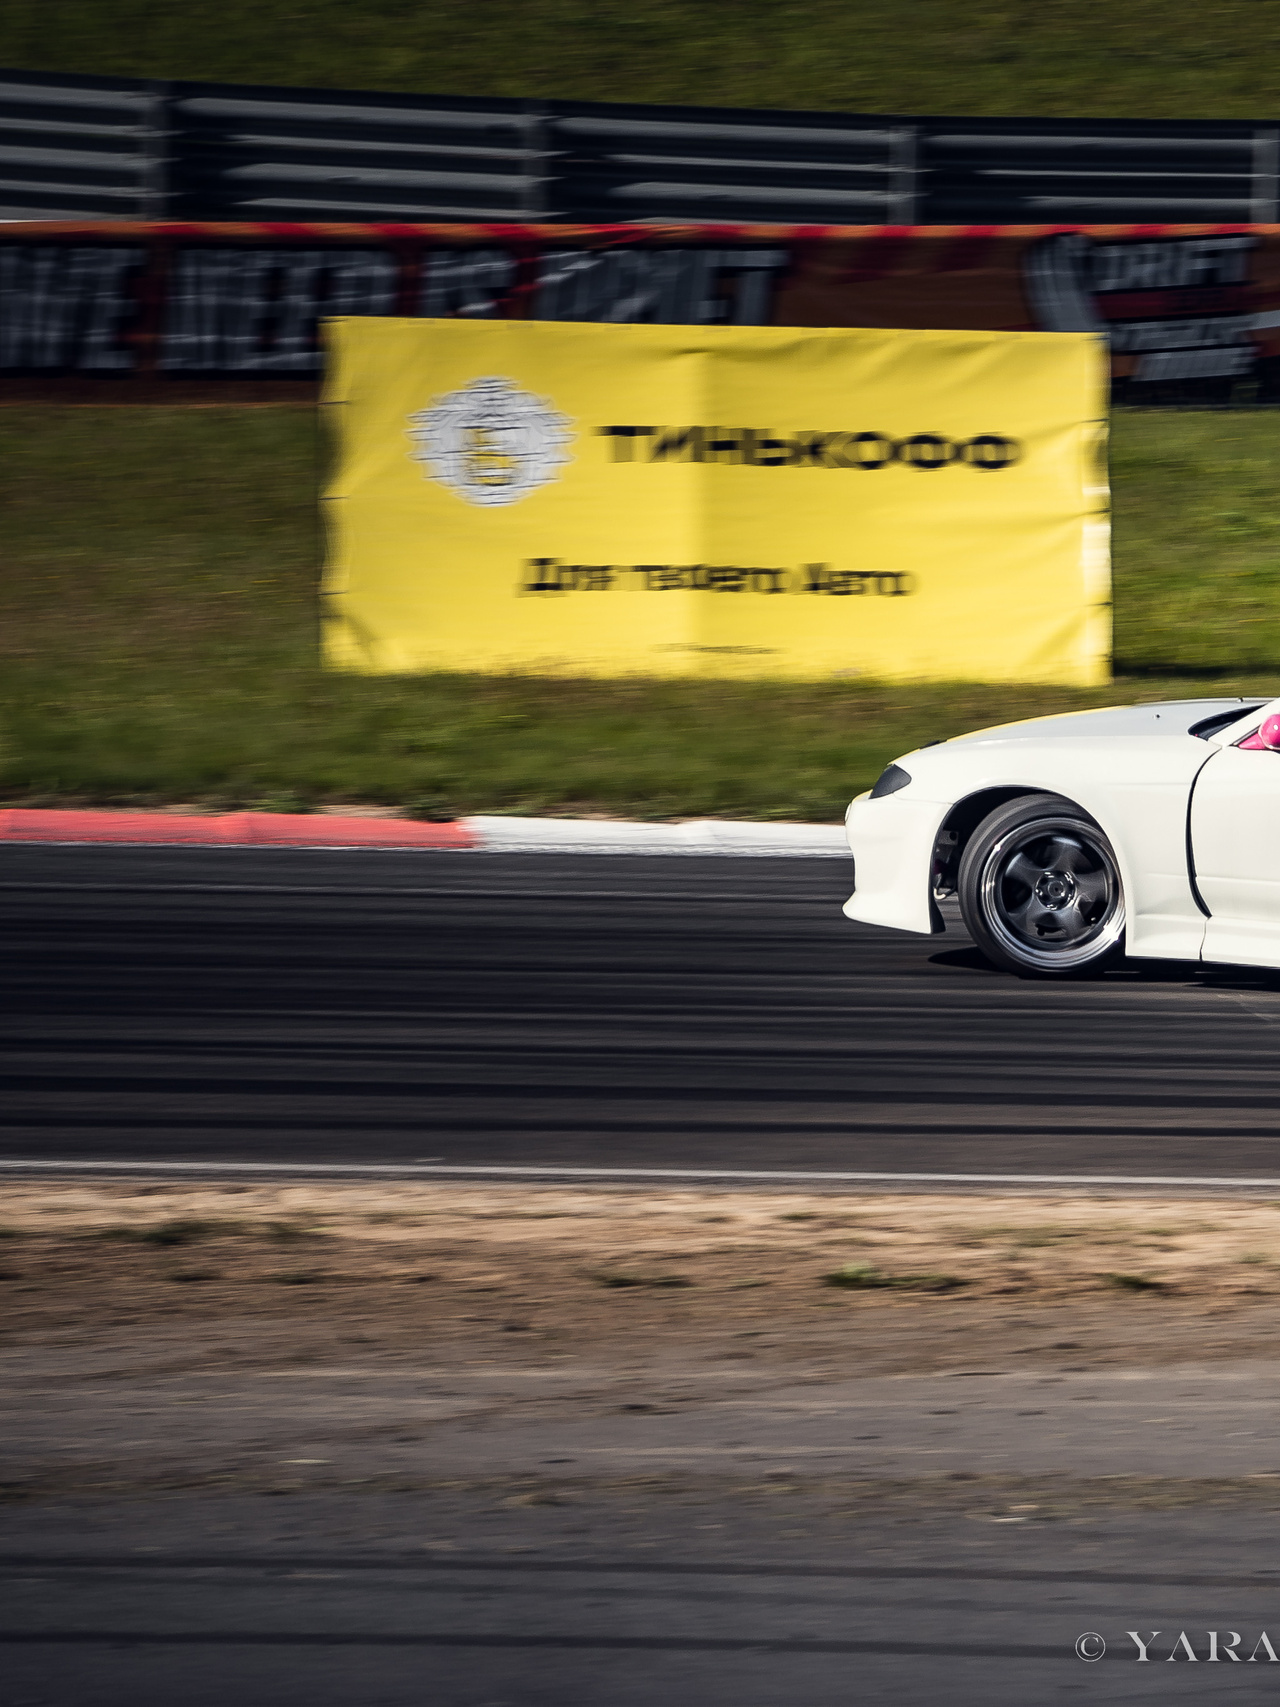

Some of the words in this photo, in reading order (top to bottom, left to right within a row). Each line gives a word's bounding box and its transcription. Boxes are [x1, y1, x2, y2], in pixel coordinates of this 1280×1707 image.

[593, 425, 1024, 473] ТИНЬКОФФ
[516, 557, 613, 597] Для
[622, 563, 791, 596] твоего
